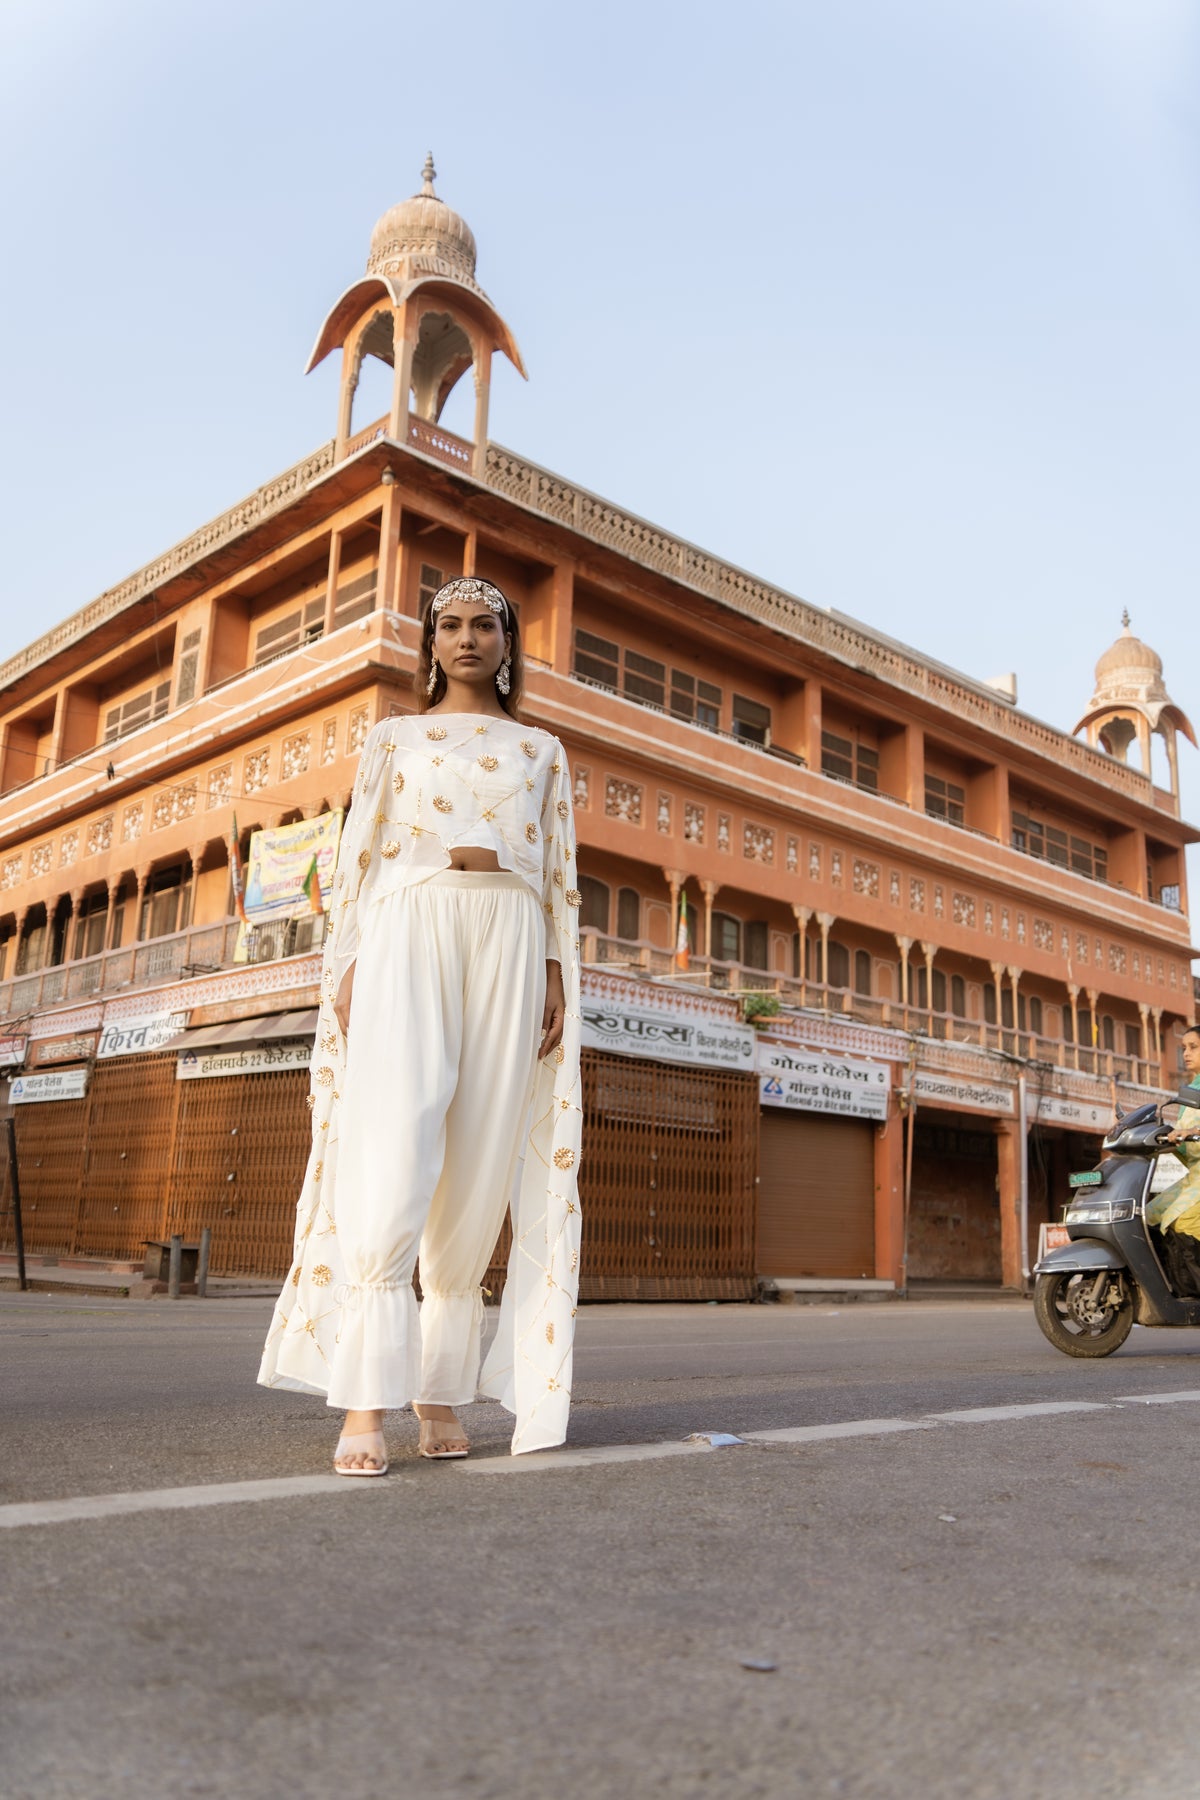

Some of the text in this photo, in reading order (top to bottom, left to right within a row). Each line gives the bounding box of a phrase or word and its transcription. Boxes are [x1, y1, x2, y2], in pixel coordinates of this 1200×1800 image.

[100, 1026, 149, 1053] किरन
[201, 1051, 248, 1073] हॉलमार्क
[250, 1054, 262, 1066] 22
[771, 1054, 869, 1082] गोल्ड पैलेस
[789, 1080, 819, 1096] गोल्ड
